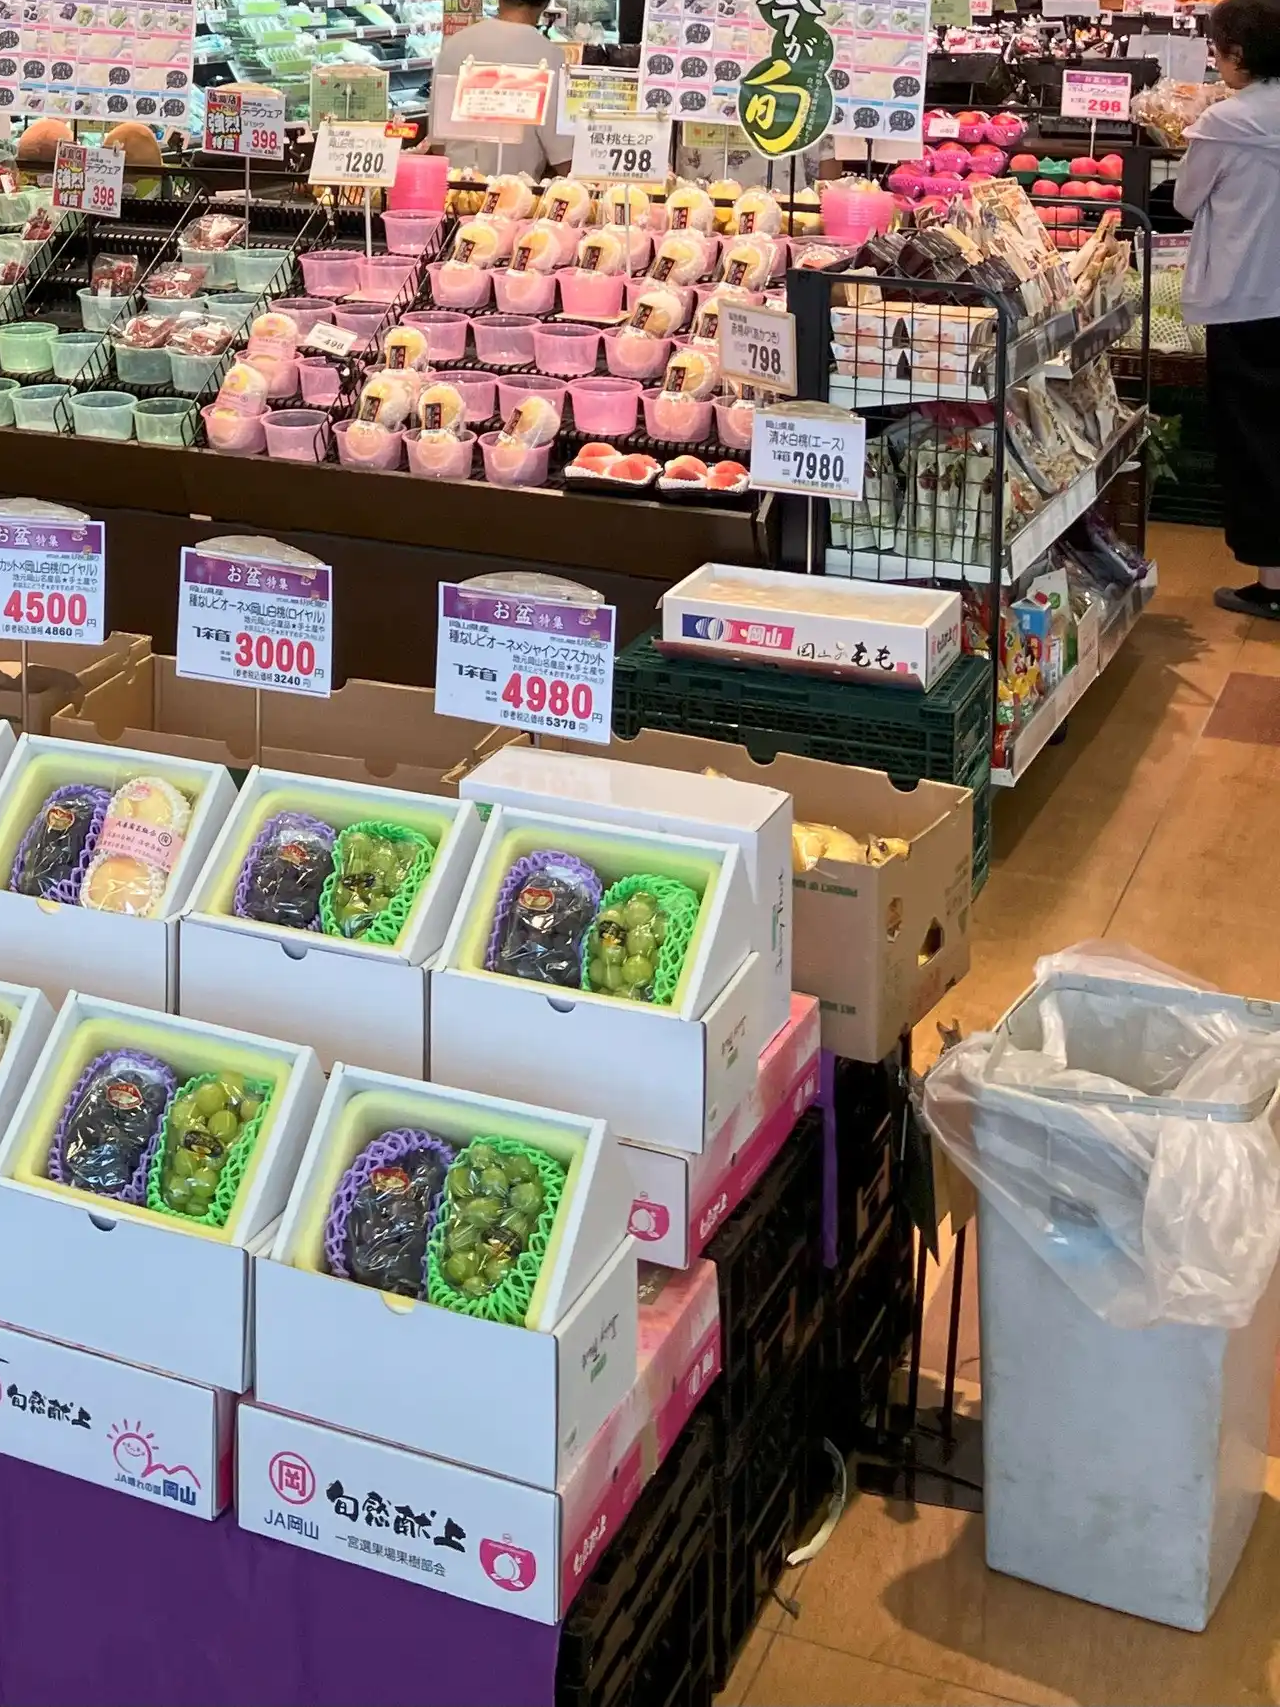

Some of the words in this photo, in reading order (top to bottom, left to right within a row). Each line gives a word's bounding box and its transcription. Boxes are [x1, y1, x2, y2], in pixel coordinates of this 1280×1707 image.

[242, 105, 283, 120] デラウェア
[1088, 98, 1122, 113] 298
[208, 113, 240, 134] 強烈
[251, 129, 278, 150] 398
[86, 162, 121, 175] デラウェア
[345, 151, 385, 174] 1280
[609, 149, 652, 173] 798
[93, 185, 115, 206] 398
[748, 343, 781, 375] 798
[769, 430, 844, 451] 清水白桃(エース)
[793, 451, 844, 482] 7980
[227, 565, 289, 590] お盆特集
[3, 590, 87, 626] 4500
[87, 618, 96, 627] 円
[493, 601, 564, 629] お盆特集
[44, 626, 72, 636] 4860
[747, 625, 783, 647] 岡山
[235, 632, 315, 675] 3000
[314, 668, 324, 678] 円
[274, 674, 300, 686] 3240
[502, 672, 592, 720] 4980
[592, 712, 603, 724] 円
[546, 718, 576, 730] 5378
[263, 1508, 320, 1541] JA岡山
[333, 1533, 447, 1578] 一宮選果場果樹部会
